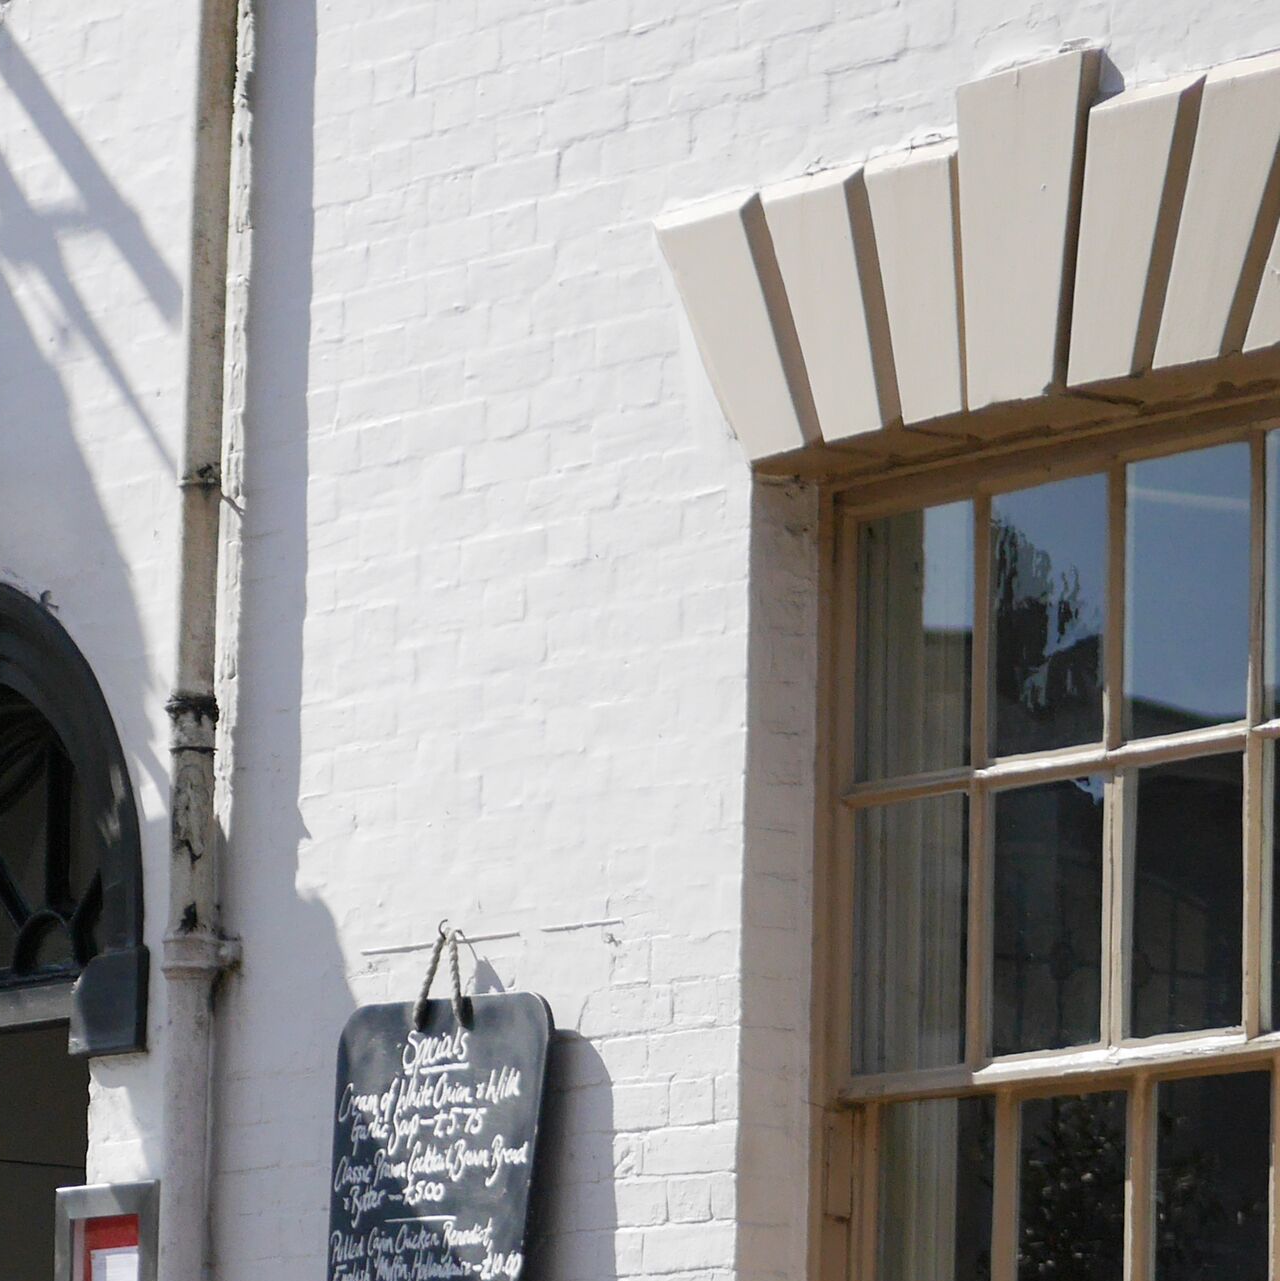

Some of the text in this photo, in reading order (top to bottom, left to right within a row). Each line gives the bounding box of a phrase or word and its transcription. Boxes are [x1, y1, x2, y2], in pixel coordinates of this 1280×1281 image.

[403, 1028, 470, 1073] Specials
[338, 1083, 379, 1122] Cream
[380, 1077, 398, 1122] of
[397, 1074, 433, 1111] White
[433, 1072, 473, 1109] Onion
[485, 1066, 521, 1104] Wild
[351, 1113, 389, 1156] Garlic
[388, 1109, 420, 1155] Soup
[334, 1155, 372, 1192] Classic
[373, 1149, 407, 1187] Prawn
[449, 1138, 489, 1182] Brown
[485, 1134, 529, 1187] Bread
[349, 1186, 386, 1228] Butter
[331, 1230, 363, 1264] Pulled
[395, 1223, 440, 1253] Chicken
